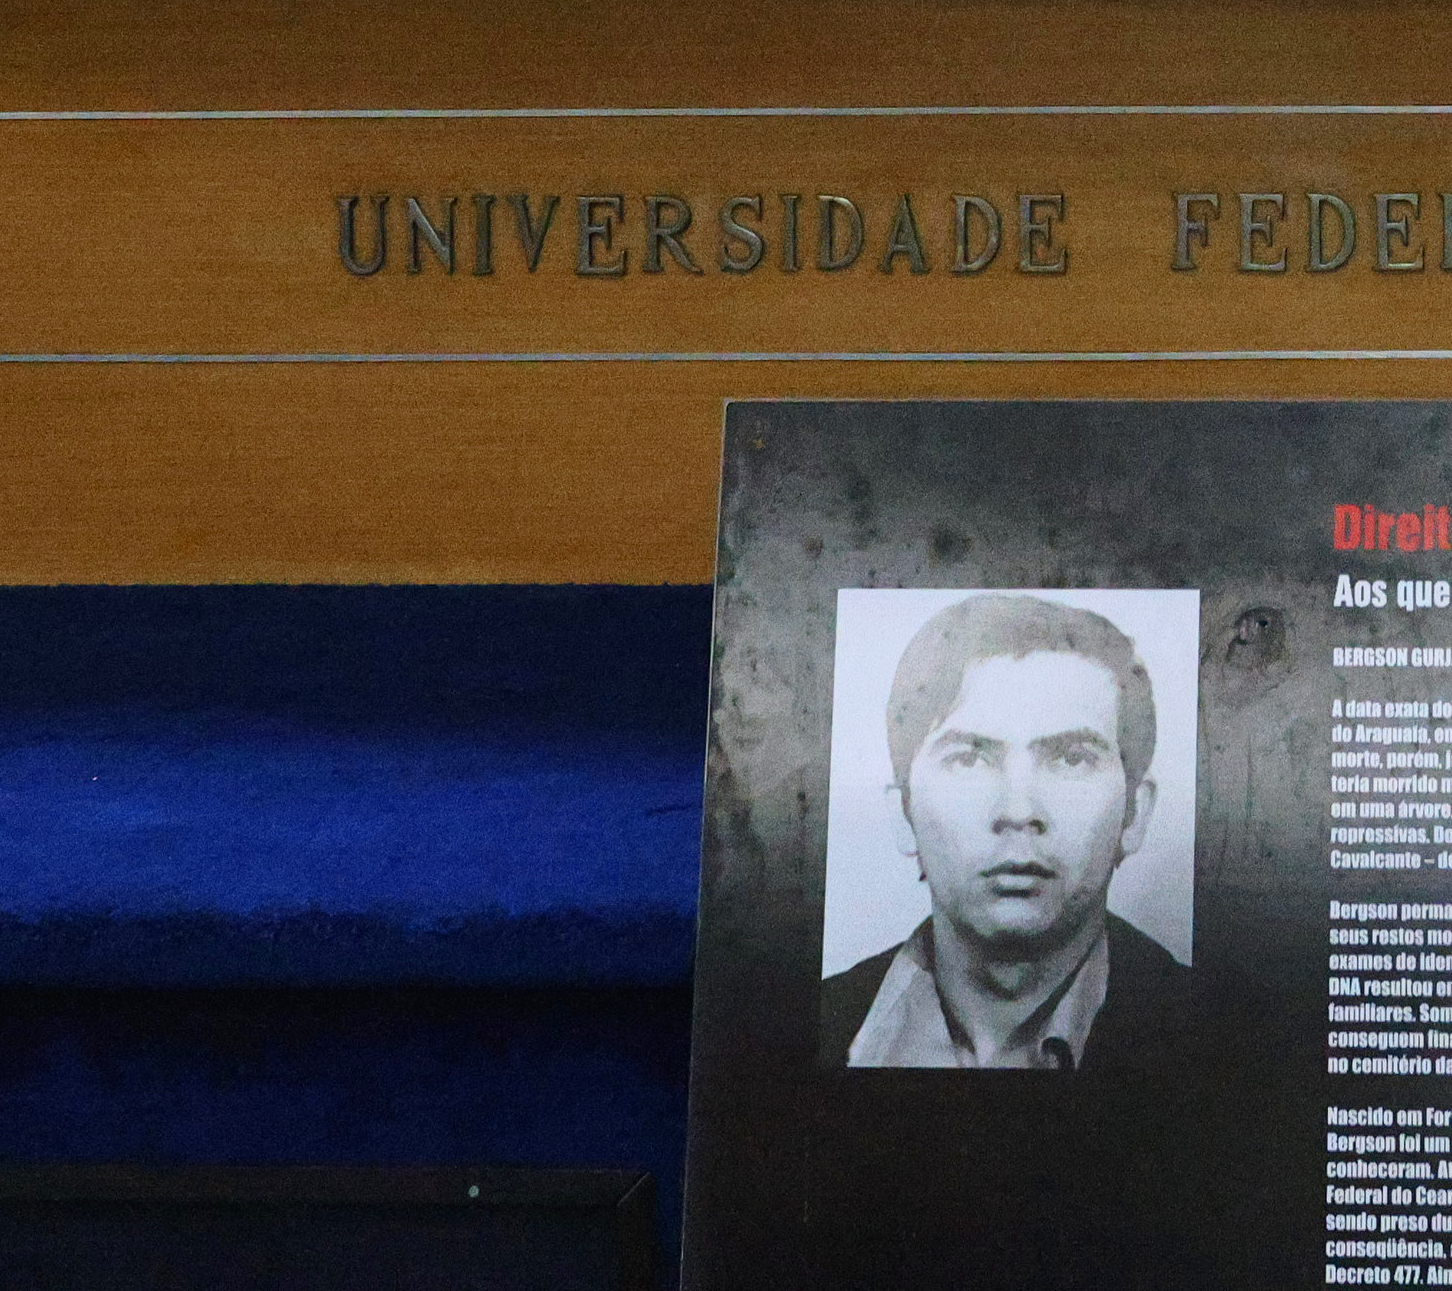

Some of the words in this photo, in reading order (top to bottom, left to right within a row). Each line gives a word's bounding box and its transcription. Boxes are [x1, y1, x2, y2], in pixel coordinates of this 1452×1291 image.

[337, 194, 1069, 276] UNIVERSIDADE
[1333, 574, 1387, 608] Aos
[1397, 578, 1450, 611] que
[1333, 647, 1407, 667] BERGSON
[1331, 776, 1370, 793] teria
[1373, 776, 1438, 794] morrido
[1330, 850, 1421, 868] Cavalcante
[1329, 901, 1398, 923] Bergson
[1328, 978, 1361, 996] DNA
[1363, 978, 1433, 996] resultou
[1327, 1060, 1349, 1073] no
[1351, 1056, 1433, 1074] cemitério
[1327, 1107, 1394, 1126] Nascido
[1396, 1111, 1423, 1126] em
[1326, 1134, 1396, 1155] Bergson
[1398, 1134, 1421, 1153] foi
[1423, 1138, 1451, 1153] um
[1325, 1186, 1388, 1205] Federal
